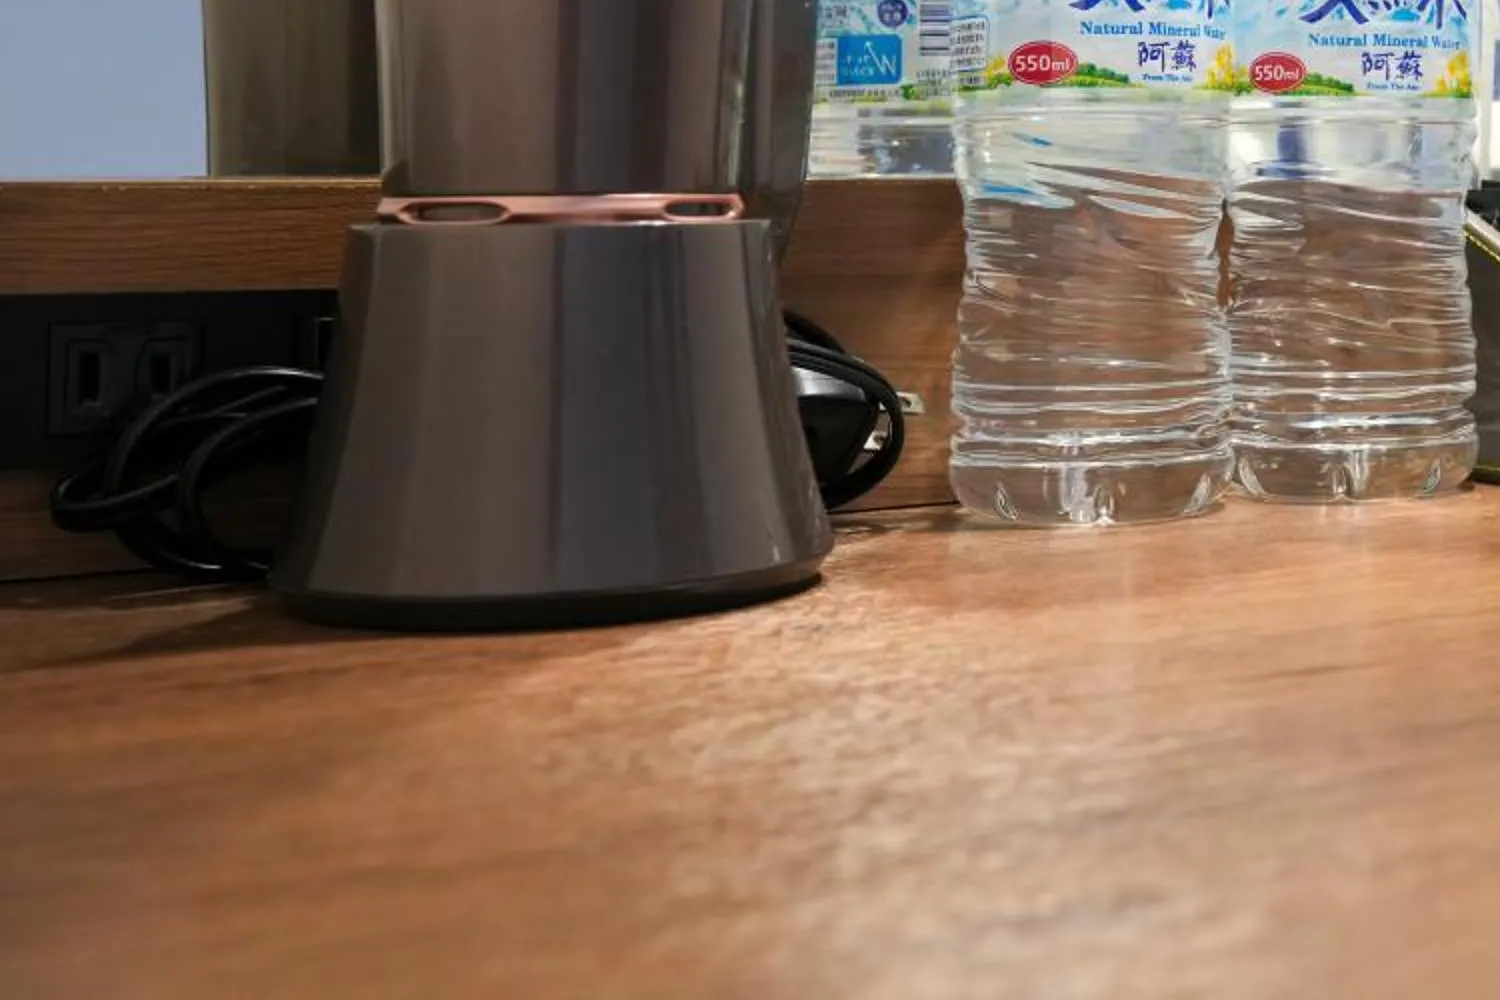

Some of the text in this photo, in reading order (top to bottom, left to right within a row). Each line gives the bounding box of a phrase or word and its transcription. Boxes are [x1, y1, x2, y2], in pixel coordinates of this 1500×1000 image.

[1079, 20, 1143, 37] Natural
[1148, 21, 1201, 38] Mineral
[1309, 32, 1463, 50] Natural Mineral Water
[1014, 54, 1071, 73] 550ml
[1136, 39, 1198, 73] 阿蘇
[1254, 64, 1300, 82] 550ml
[1361, 50, 1424, 81] 阿蘇
